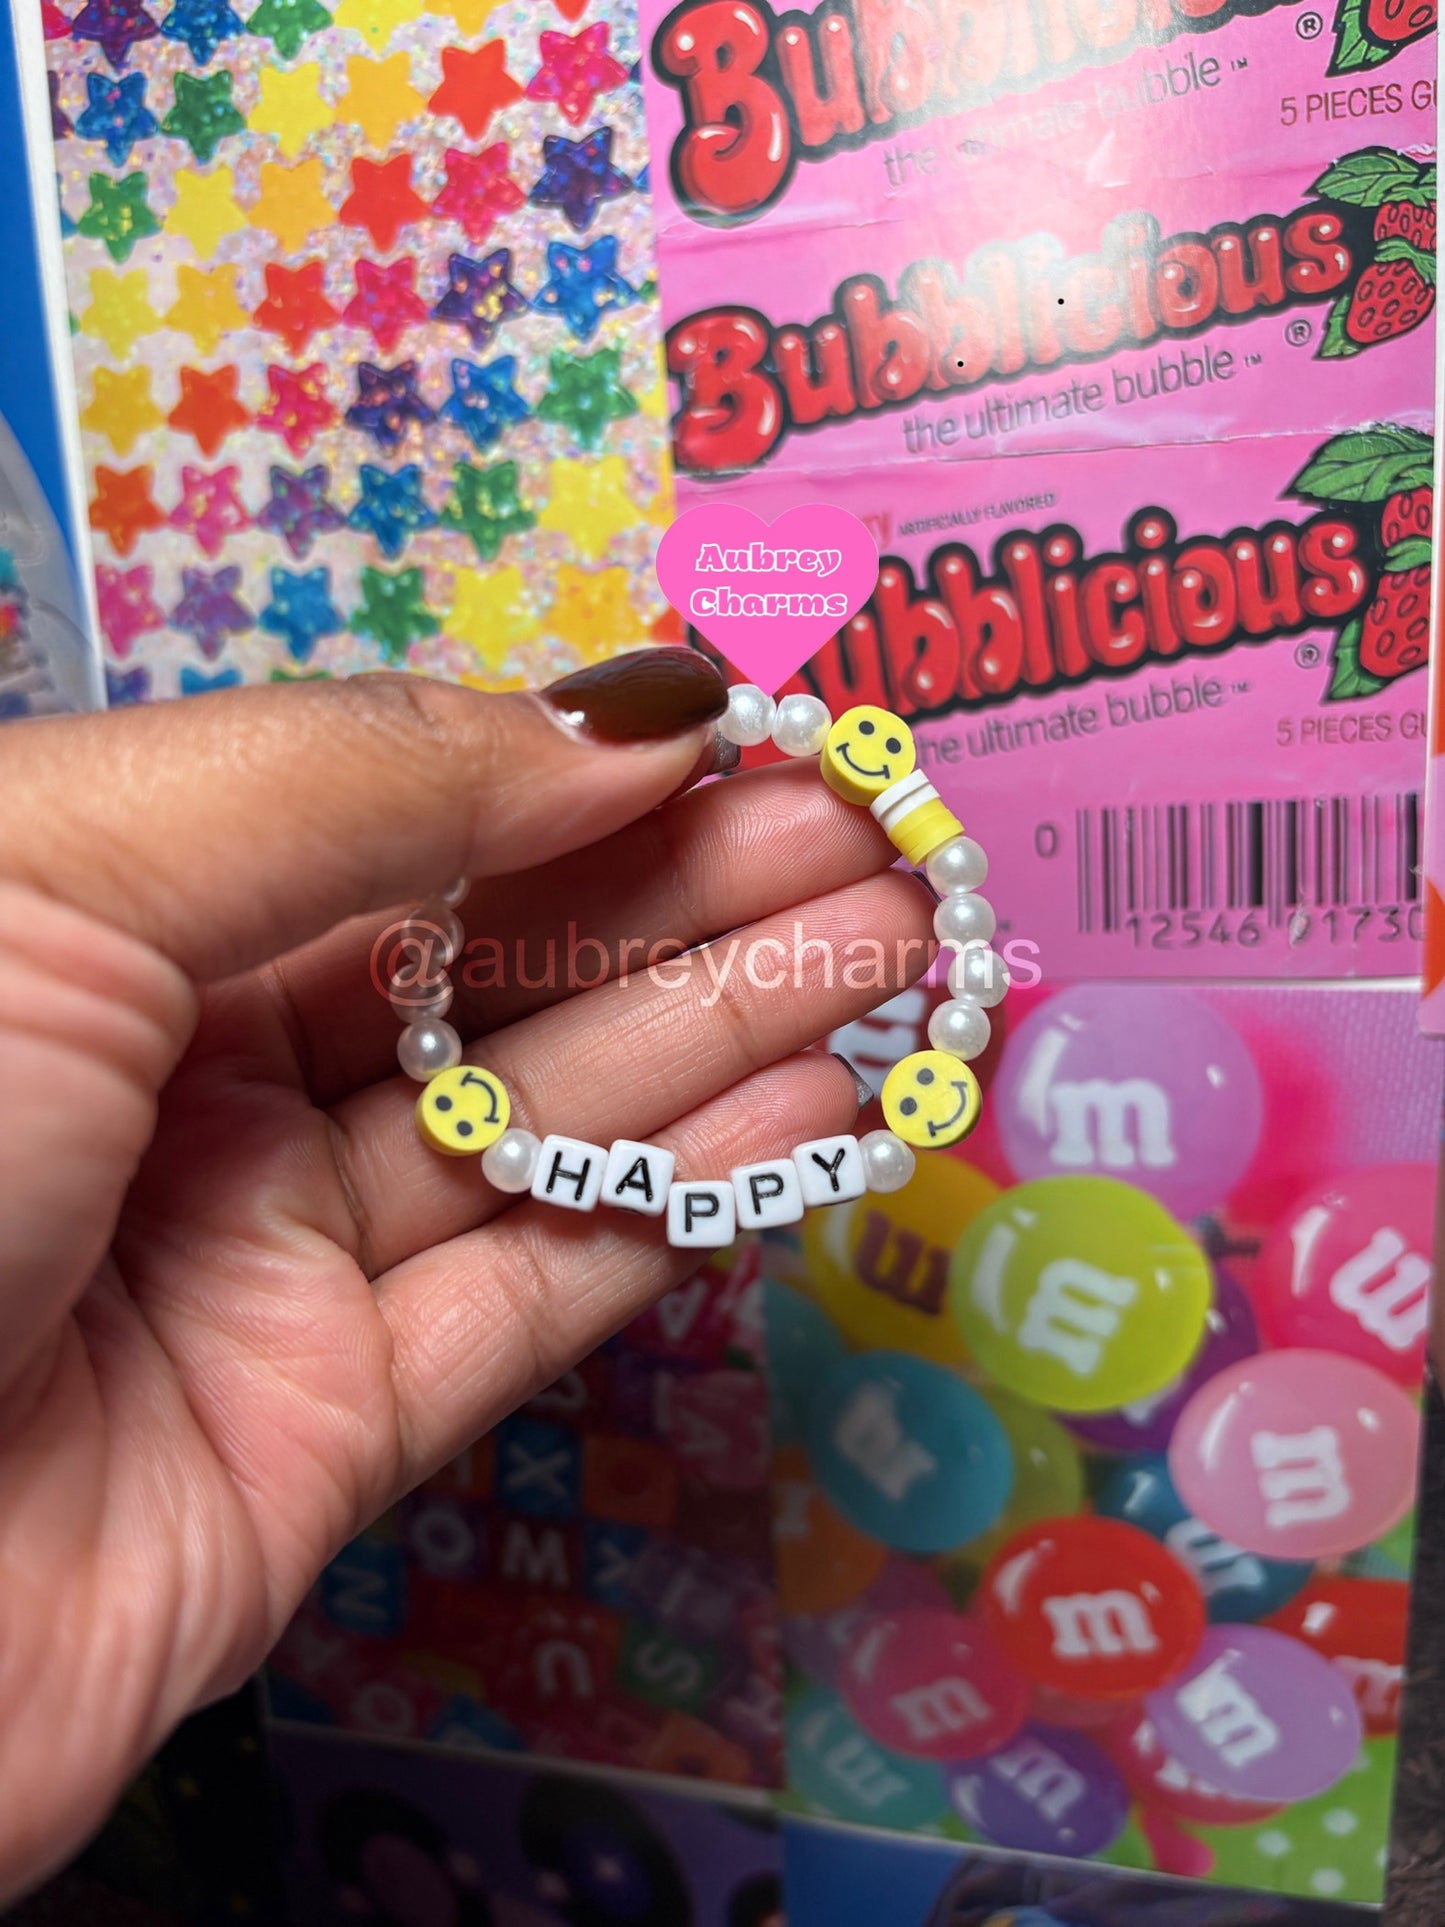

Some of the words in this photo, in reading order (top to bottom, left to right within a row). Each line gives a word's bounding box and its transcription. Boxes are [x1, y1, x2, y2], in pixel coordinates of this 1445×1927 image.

[883, 144, 941, 187] the
[1095, 52, 1222, 120] bubble
[1281, 96, 1297, 126] 5
[1306, 83, 1403, 123] PIECES
[1411, 80, 1437, 111] G
[665, 212, 1357, 482] Bubblicious
[904, 414, 959, 454] the
[964, 377, 1106, 439] ultimate
[1112, 345, 1235, 405] bubble
[917, 731, 963, 767] he
[968, 702, 1098, 760] ultimate
[1106, 674, 1224, 728] bubble
[1276, 718, 1292, 748] 5
[1301, 713, 1393, 746] PIECES
[1034, 822, 1059, 859] 0
[1125, 908, 1263, 951] 12546
[1049, 1079, 1176, 1166] m
[545, 1146, 847, 1234] HAPPY
[1041, 1589, 1160, 1658] m
